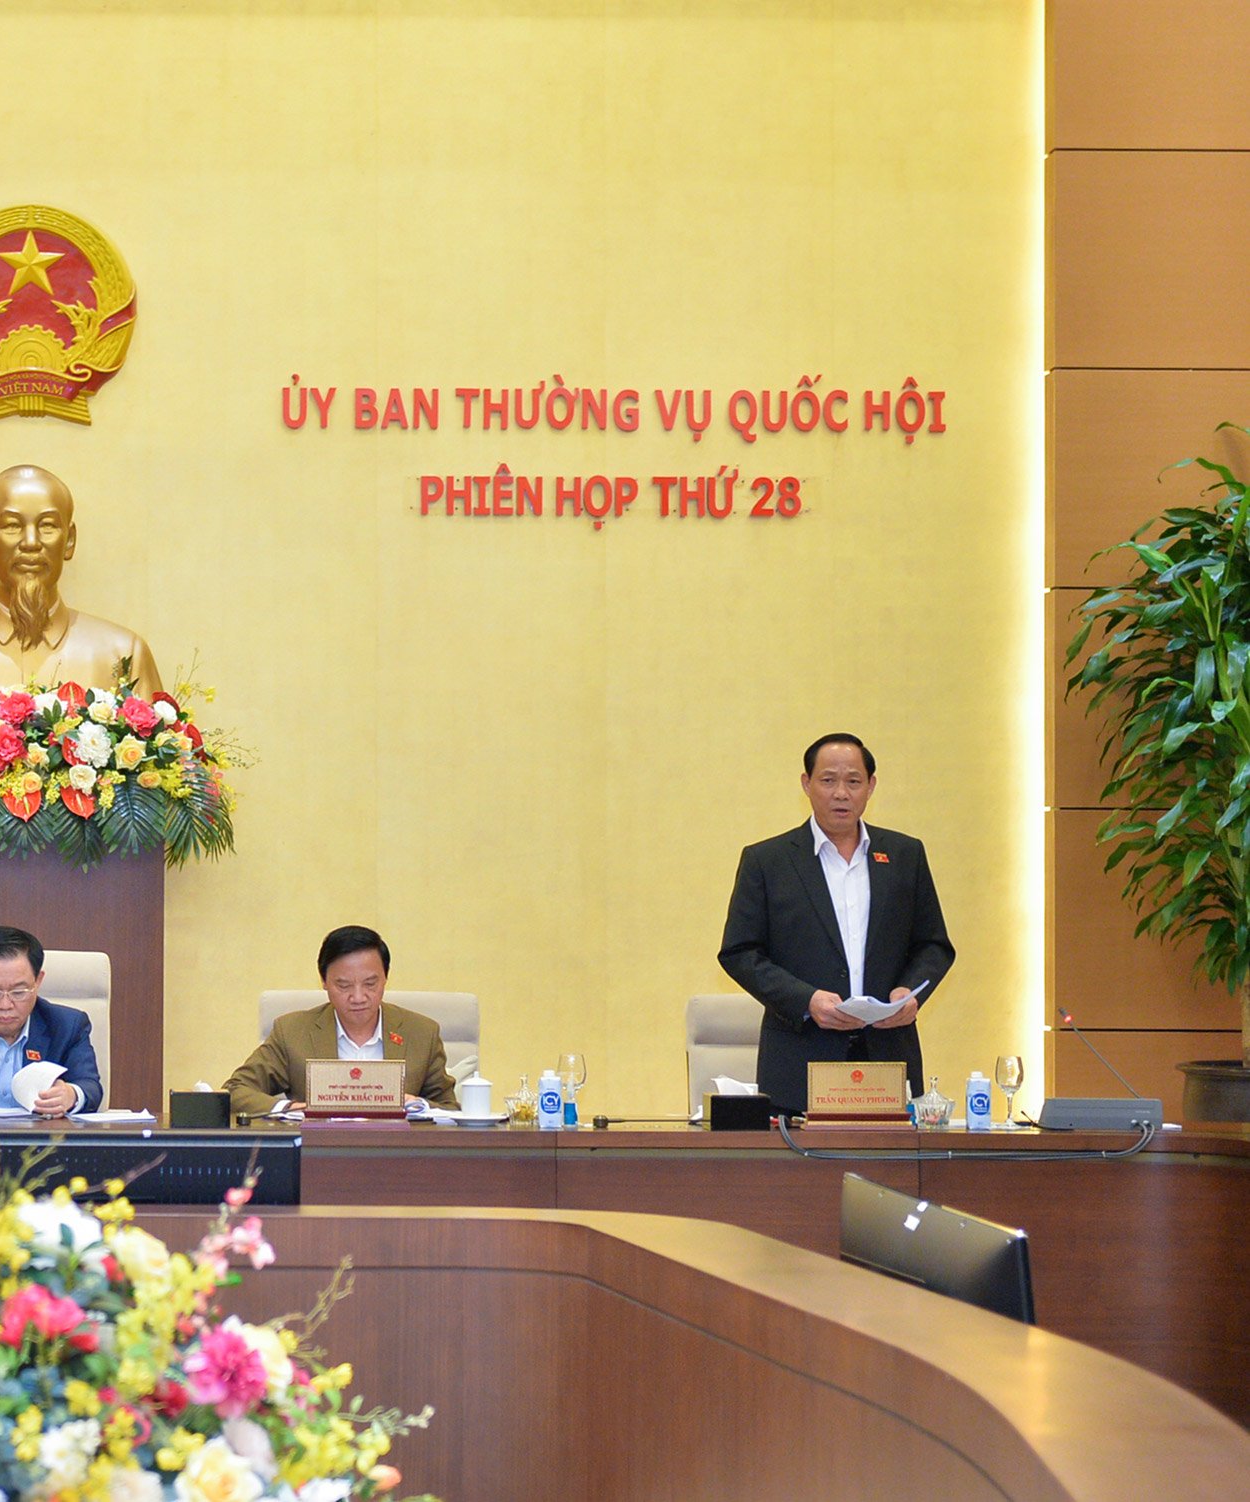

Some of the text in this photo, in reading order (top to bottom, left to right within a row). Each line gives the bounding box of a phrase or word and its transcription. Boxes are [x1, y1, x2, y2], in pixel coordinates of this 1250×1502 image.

[32, 382, 64, 395] NAM
[281, 374, 947, 444] ỦY BAN THƯỜNG VỤ QUỐC HỘI
[419, 463, 803, 530] PHIÊN HỌP THỨ 28
[543, 1095, 559, 1105] ICY
[972, 1096, 989, 1107] ICY
